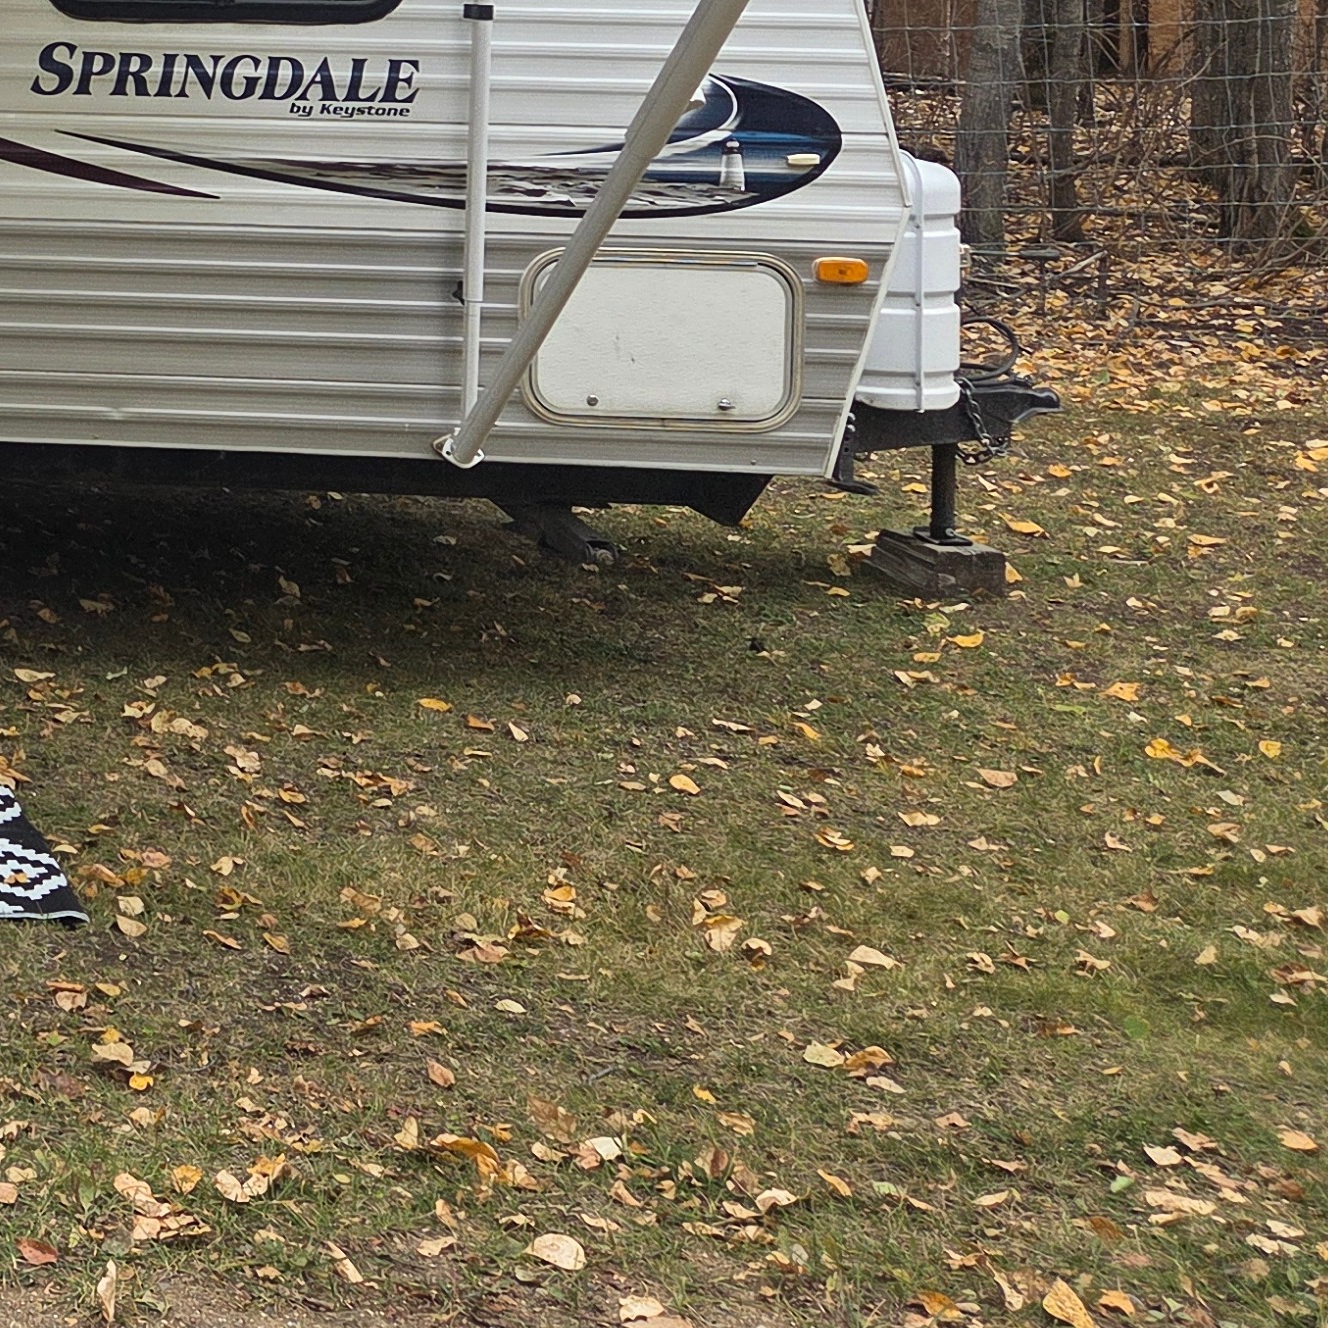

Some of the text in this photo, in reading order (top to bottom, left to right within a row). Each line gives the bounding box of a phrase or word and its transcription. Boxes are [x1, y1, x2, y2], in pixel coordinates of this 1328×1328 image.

[30, 41, 421, 103] SPRINGDALE
[289, 102, 411, 119] by Keystone
